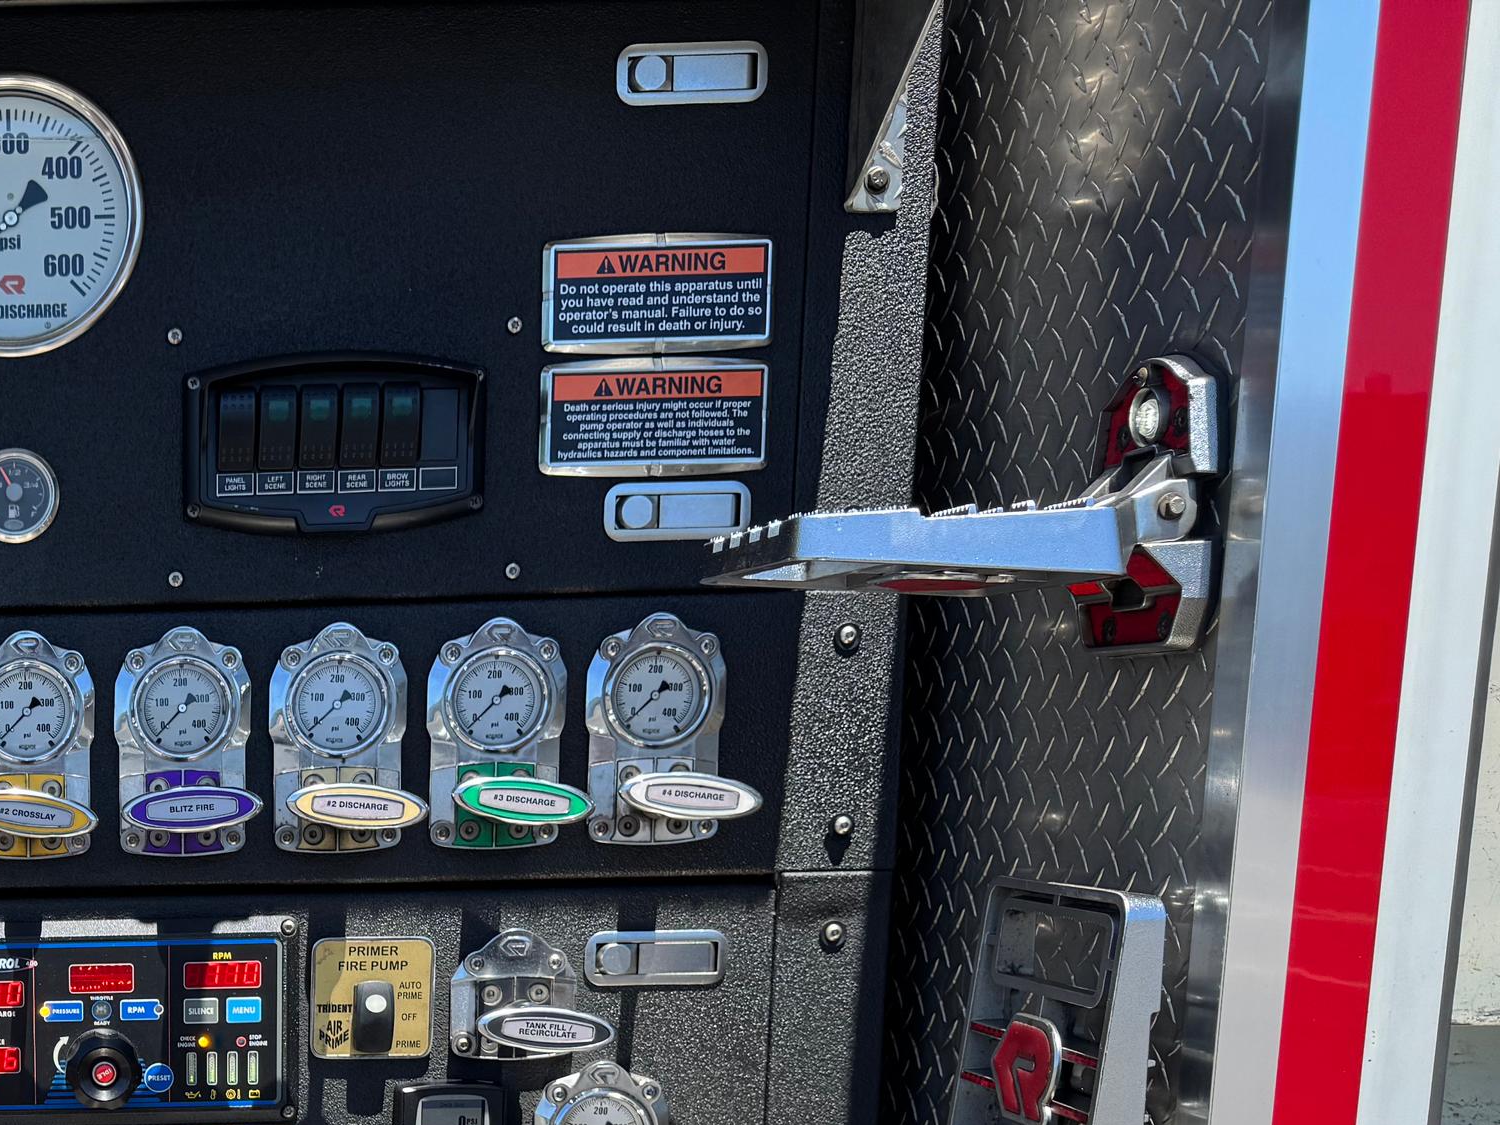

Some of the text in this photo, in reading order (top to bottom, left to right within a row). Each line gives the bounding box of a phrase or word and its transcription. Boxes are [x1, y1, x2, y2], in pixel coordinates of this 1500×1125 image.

[41, 156, 82, 179] 400
[50, 206, 90, 229] 500
[0, 234, 21, 251] psi
[44, 254, 84, 277] 600
[619, 252, 726, 273] WARNING
[560, 278, 762, 295] Do not operate this apparatus until
[561, 292, 760, 310] you have read and understand the
[559, 305, 762, 322] operator's manual. Failure to do so
[572, 319, 745, 334] could result in death or injury.
[615, 376, 722, 395] WARNING
[564, 404, 588, 412] Death
[636, 402, 660, 412] injury
[663, 401, 687, 411] might
[723, 401, 751, 410] proper
[346, 480, 368, 488] SCENE
[385, 479, 409, 487] LIGHTS
[494, 794, 555, 807] #3 DISCHARGE
[662, 789, 724, 801] #4 DISCHARGE
[169, 803, 214, 814] BLITZ FIRE
[327, 800, 389, 811] #2 DISCHARGE
[0, 807, 55, 821] #2 CROSSLAY
[213, 952, 232, 960] RPM
[349, 946, 399, 956] PRIMER
[338, 961, 408, 971] FIRE PUMP
[188, 1007, 214, 1015] SILENCE
[317, 1004, 352, 1013] TRIDENT
[327, 1020, 342, 1036] AIR
[549, 1023, 567, 1031] FILL
[319, 1029, 349, 1049] PRIME
[518, 1028, 577, 1039] RECIRCULATE
[396, 1040, 420, 1048] PRIME
